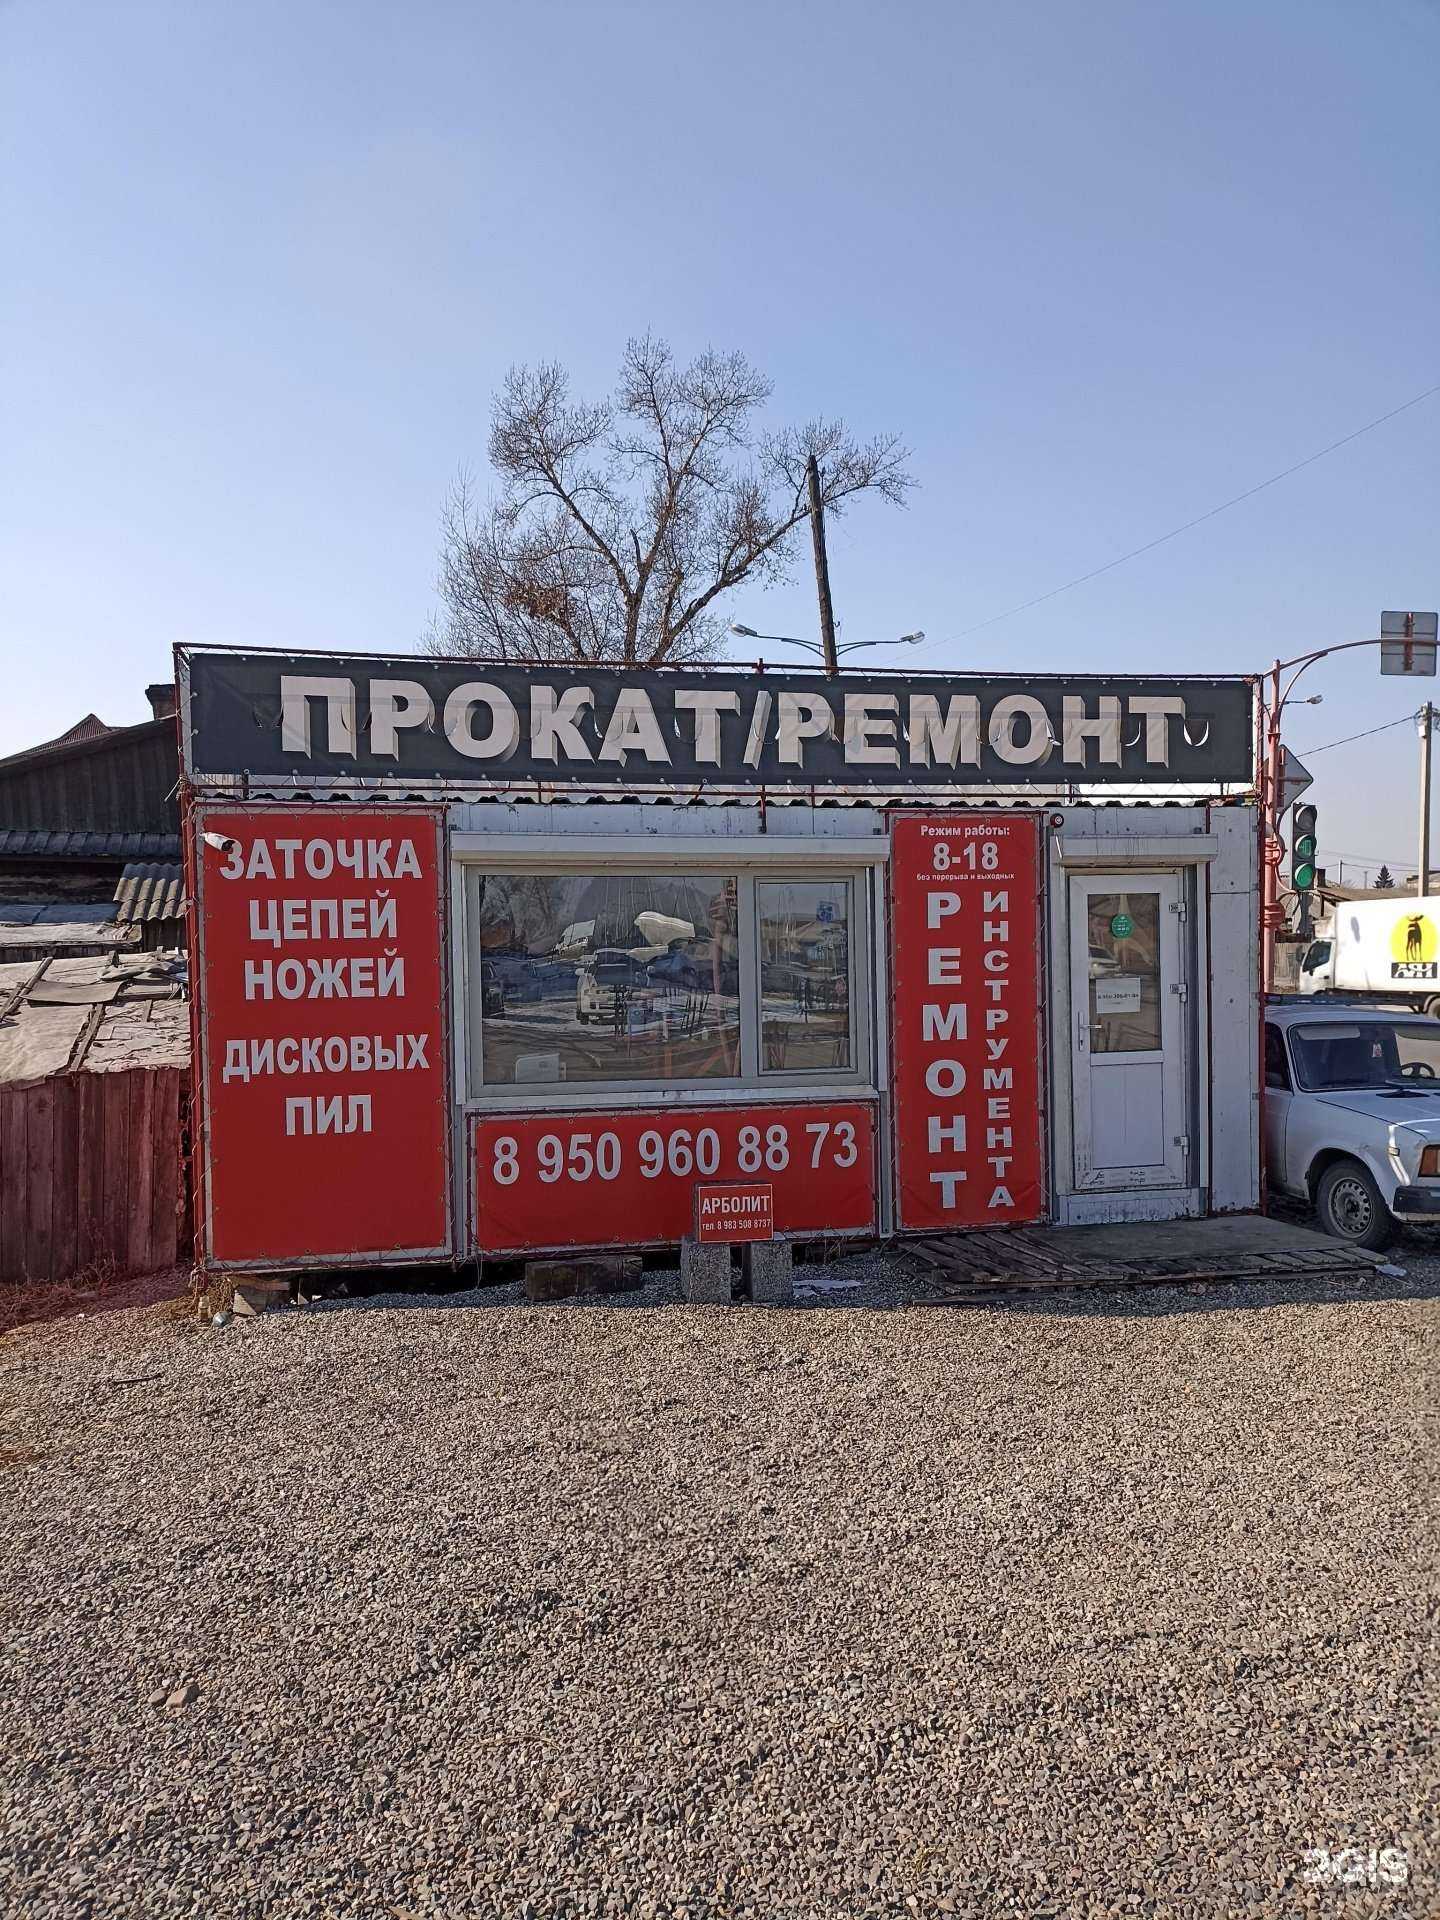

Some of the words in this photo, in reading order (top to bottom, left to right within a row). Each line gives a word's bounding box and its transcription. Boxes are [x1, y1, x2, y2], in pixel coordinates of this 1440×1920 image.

[280, 675, 1186, 769] ПРОКАТ/РЕМОНТ
[920, 825, 961, 836] Режим
[964, 824, 1010, 838] работы:
[219, 838, 423, 880] ЗАТОЧКА
[916, 873, 931, 881] без
[976, 872, 1015, 880] выходных
[933, 842, 999, 871] 8-18
[249, 889, 398, 948] ЦЕПЕЙ
[244, 947, 405, 1000] НОЖЕЙ
[222, 1033, 430, 1084] ДИСКОВЫХ
[922, 892, 968, 1209] РЕМОНТ
[982, 891, 1015, 1208] ИНСТРУМЕНТА
[285, 1094, 372, 1136] ПИЛ
[493, 1136, 520, 1185] 8
[537, 1132, 621, 1183] 950
[638, 1128, 720, 1177] 960
[737, 1125, 790, 1172] 88
[805, 1121, 858, 1168] 73
[701, 1195, 770, 1214] АРБОЛИТ
[717, 1221, 722, 1230] 8
[723, 1220, 737, 1230] 983
